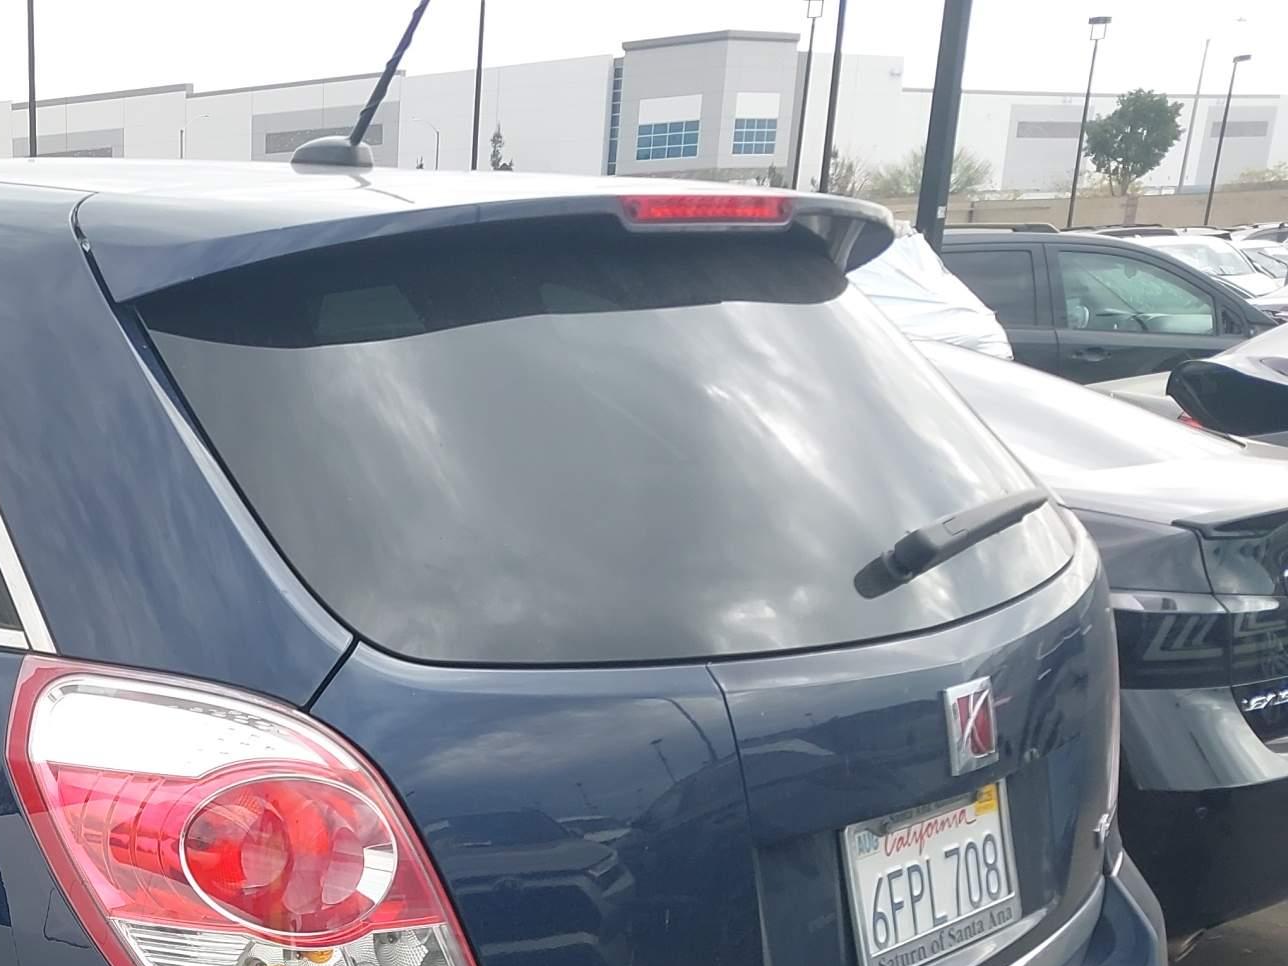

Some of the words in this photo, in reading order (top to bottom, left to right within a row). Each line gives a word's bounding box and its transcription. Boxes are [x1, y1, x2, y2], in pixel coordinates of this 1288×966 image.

[883, 807, 978, 857] California
[930, 934, 947, 959] of
[947, 915, 985, 948] Santa
[986, 904, 1013, 932] Ana
